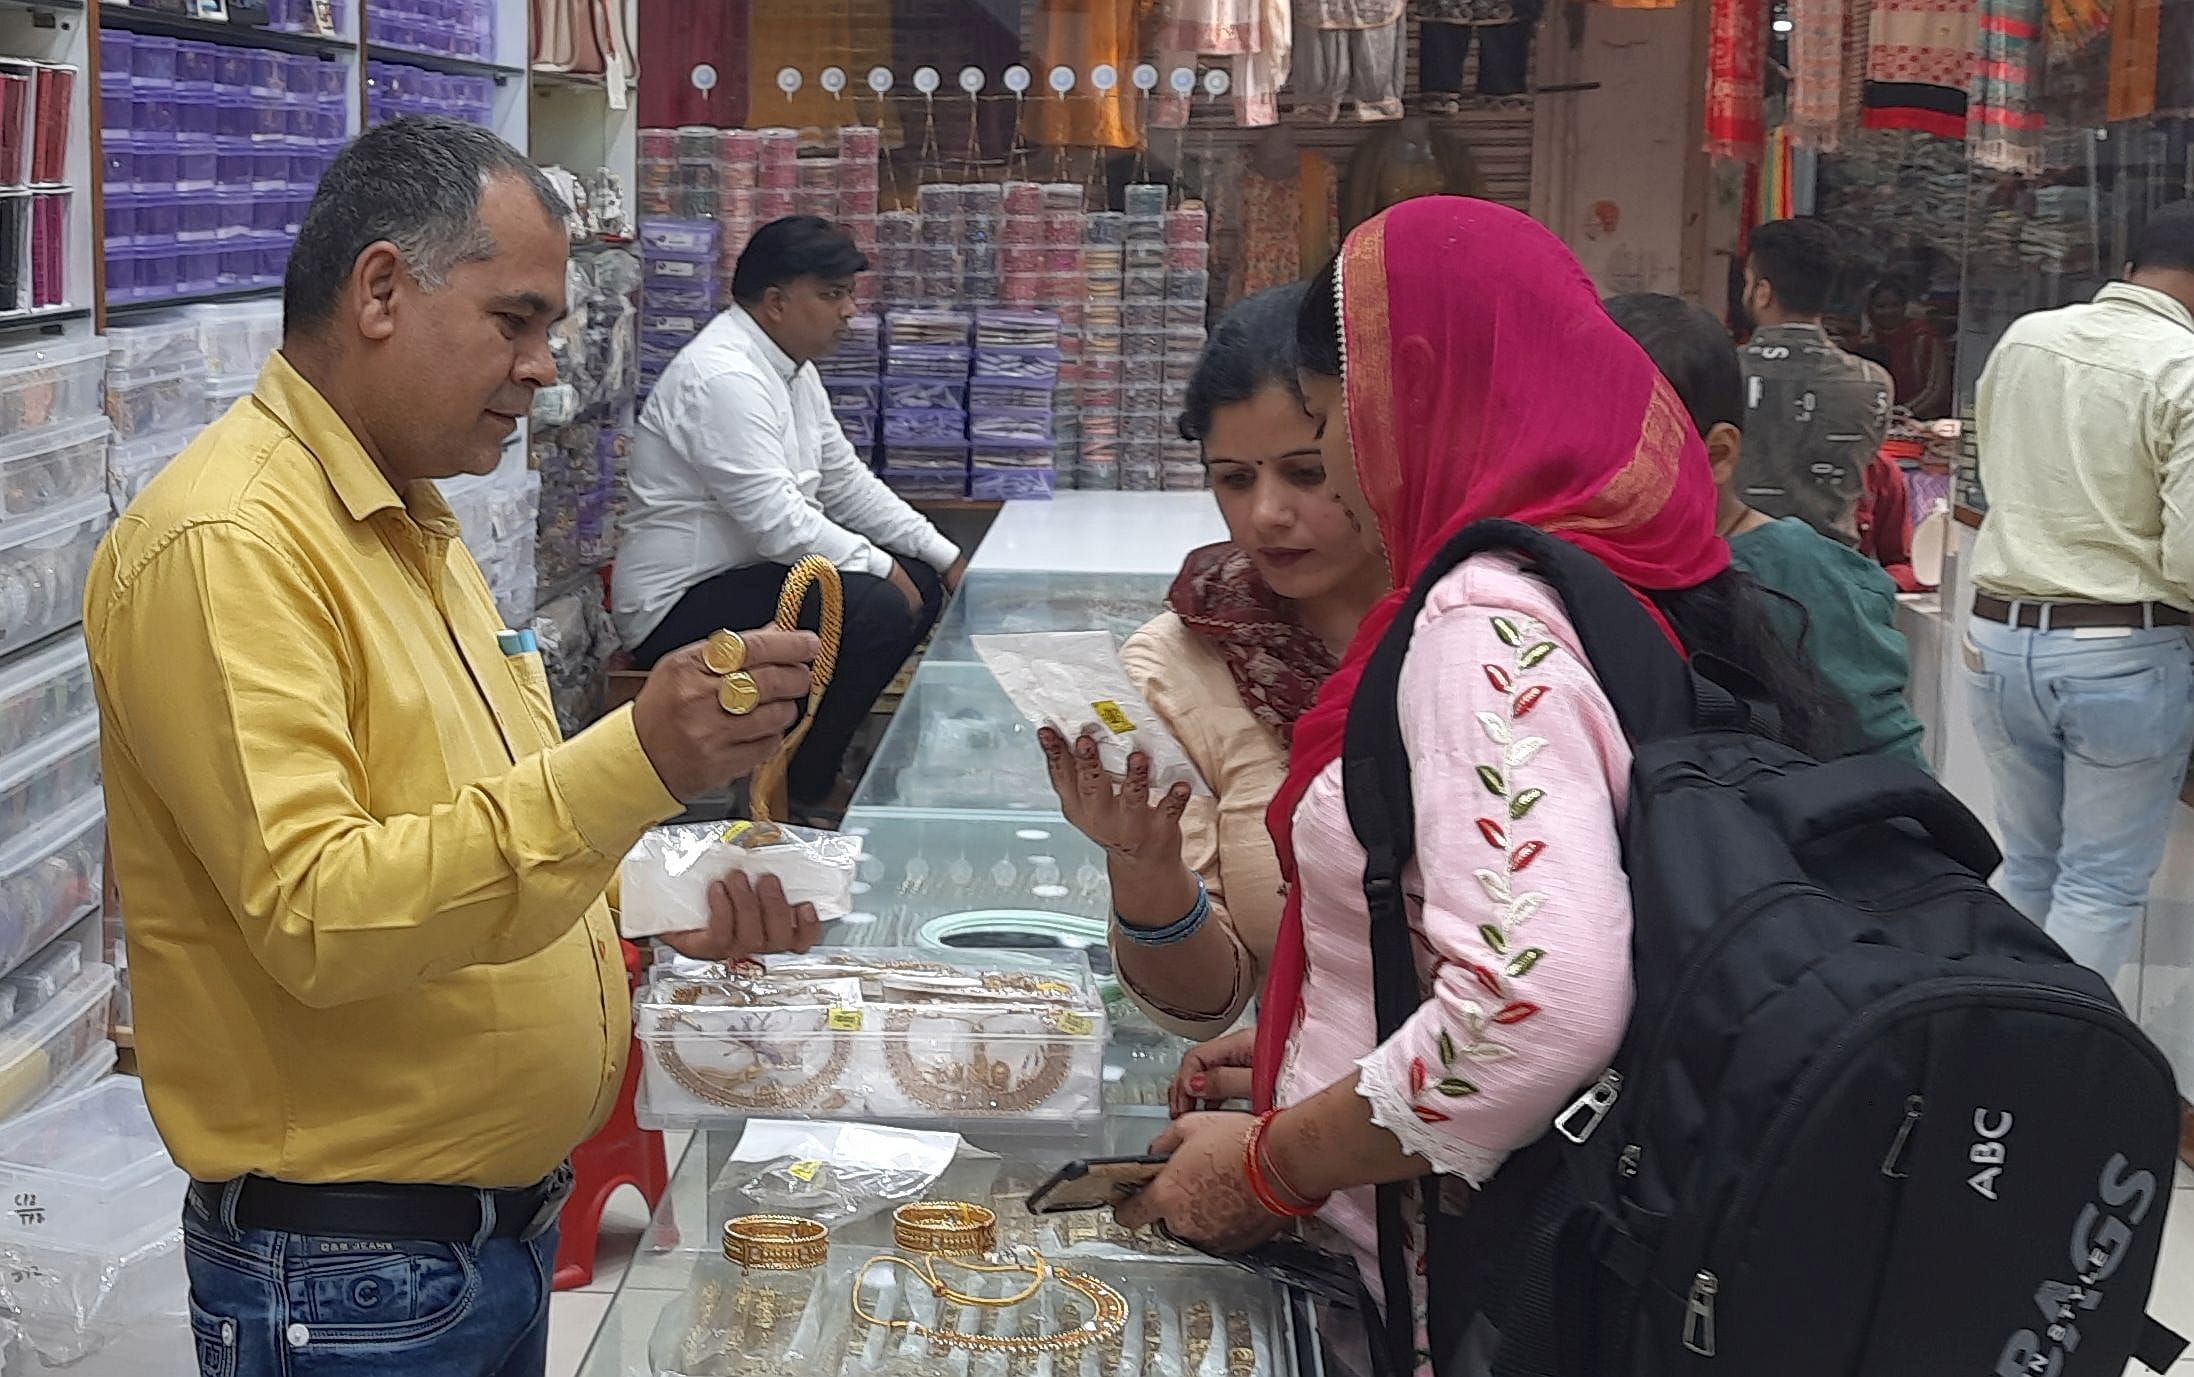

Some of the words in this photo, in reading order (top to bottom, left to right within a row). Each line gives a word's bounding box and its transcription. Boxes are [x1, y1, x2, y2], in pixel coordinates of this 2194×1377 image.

[1967, 1107, 2014, 1201] ABC
[353, 1278, 379, 1307] C
[1994, 1151, 2157, 1377] BAGS
[2046, 1247, 2110, 1342] STYLE
